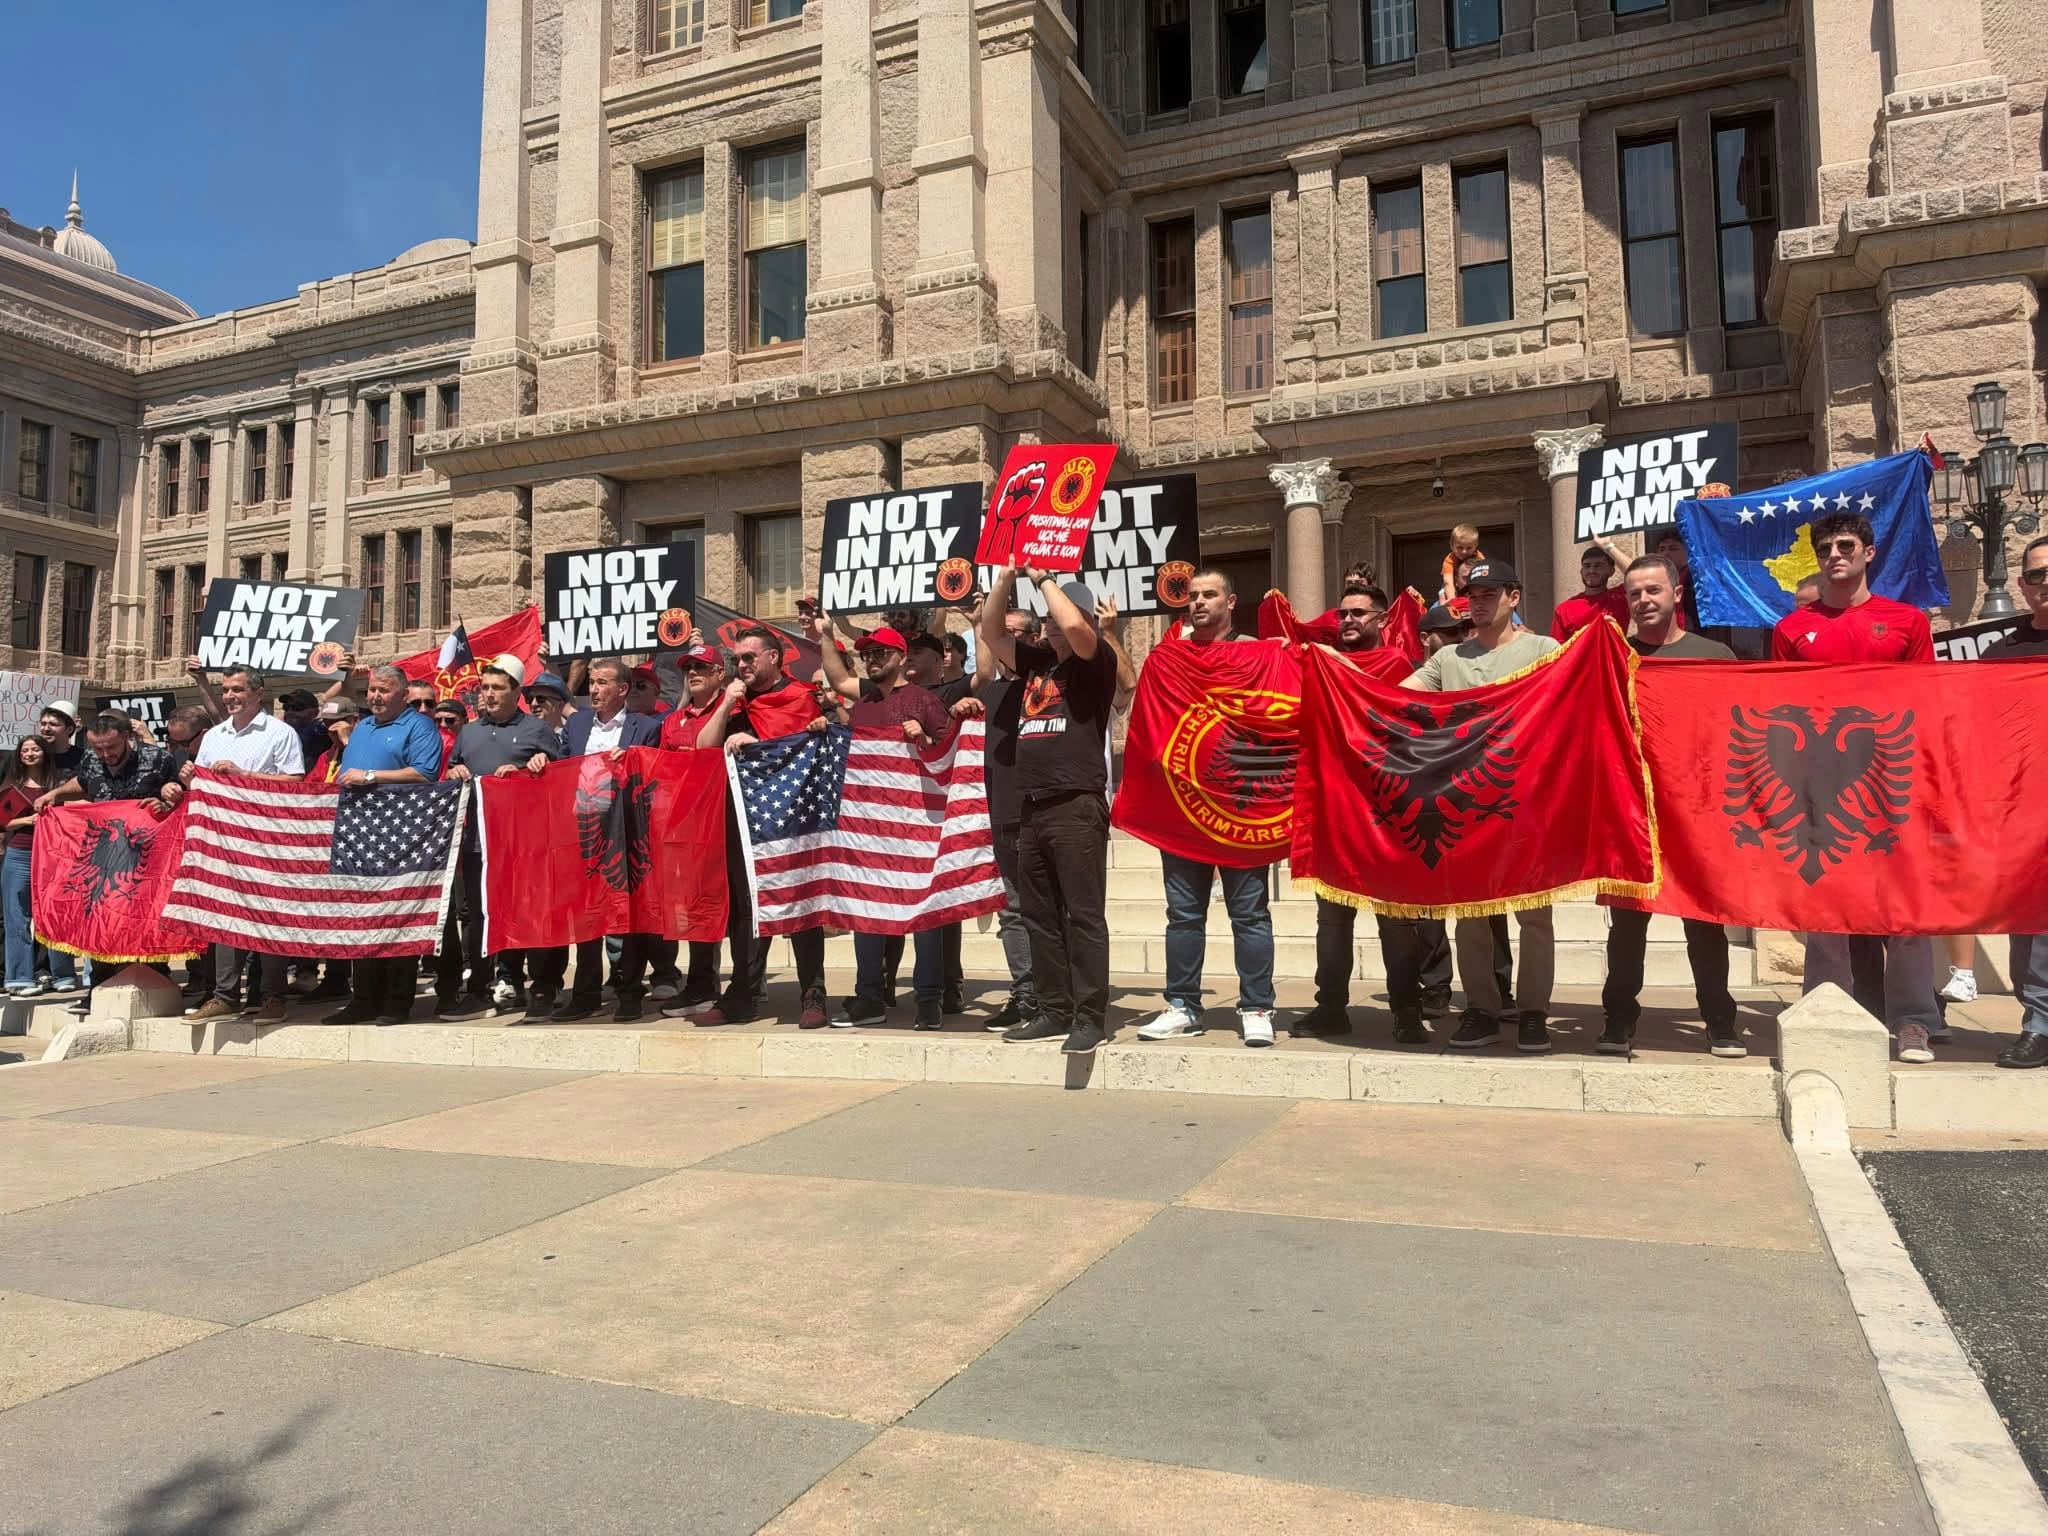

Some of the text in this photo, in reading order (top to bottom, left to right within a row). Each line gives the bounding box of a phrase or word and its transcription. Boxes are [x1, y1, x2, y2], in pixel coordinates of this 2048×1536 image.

[1602, 430, 1708, 478] NOT
[1591, 457, 1717, 506] IN MY
[848, 490, 953, 537] NOT
[1092, 485, 1164, 532] OT
[568, 547, 669, 588] NOT
[835, 526, 961, 571] IN MY
[1093, 525, 1177, 569] MY
[230, 583, 338, 617] NOT
[559, 579, 678, 619] IN MY
[822, 562, 938, 611] NAME
[1016, 566, 1158, 618] NME
[213, 610, 340, 643] IN MY
[549, 612, 658, 656] NAME
[198, 636, 313, 672] NAME
